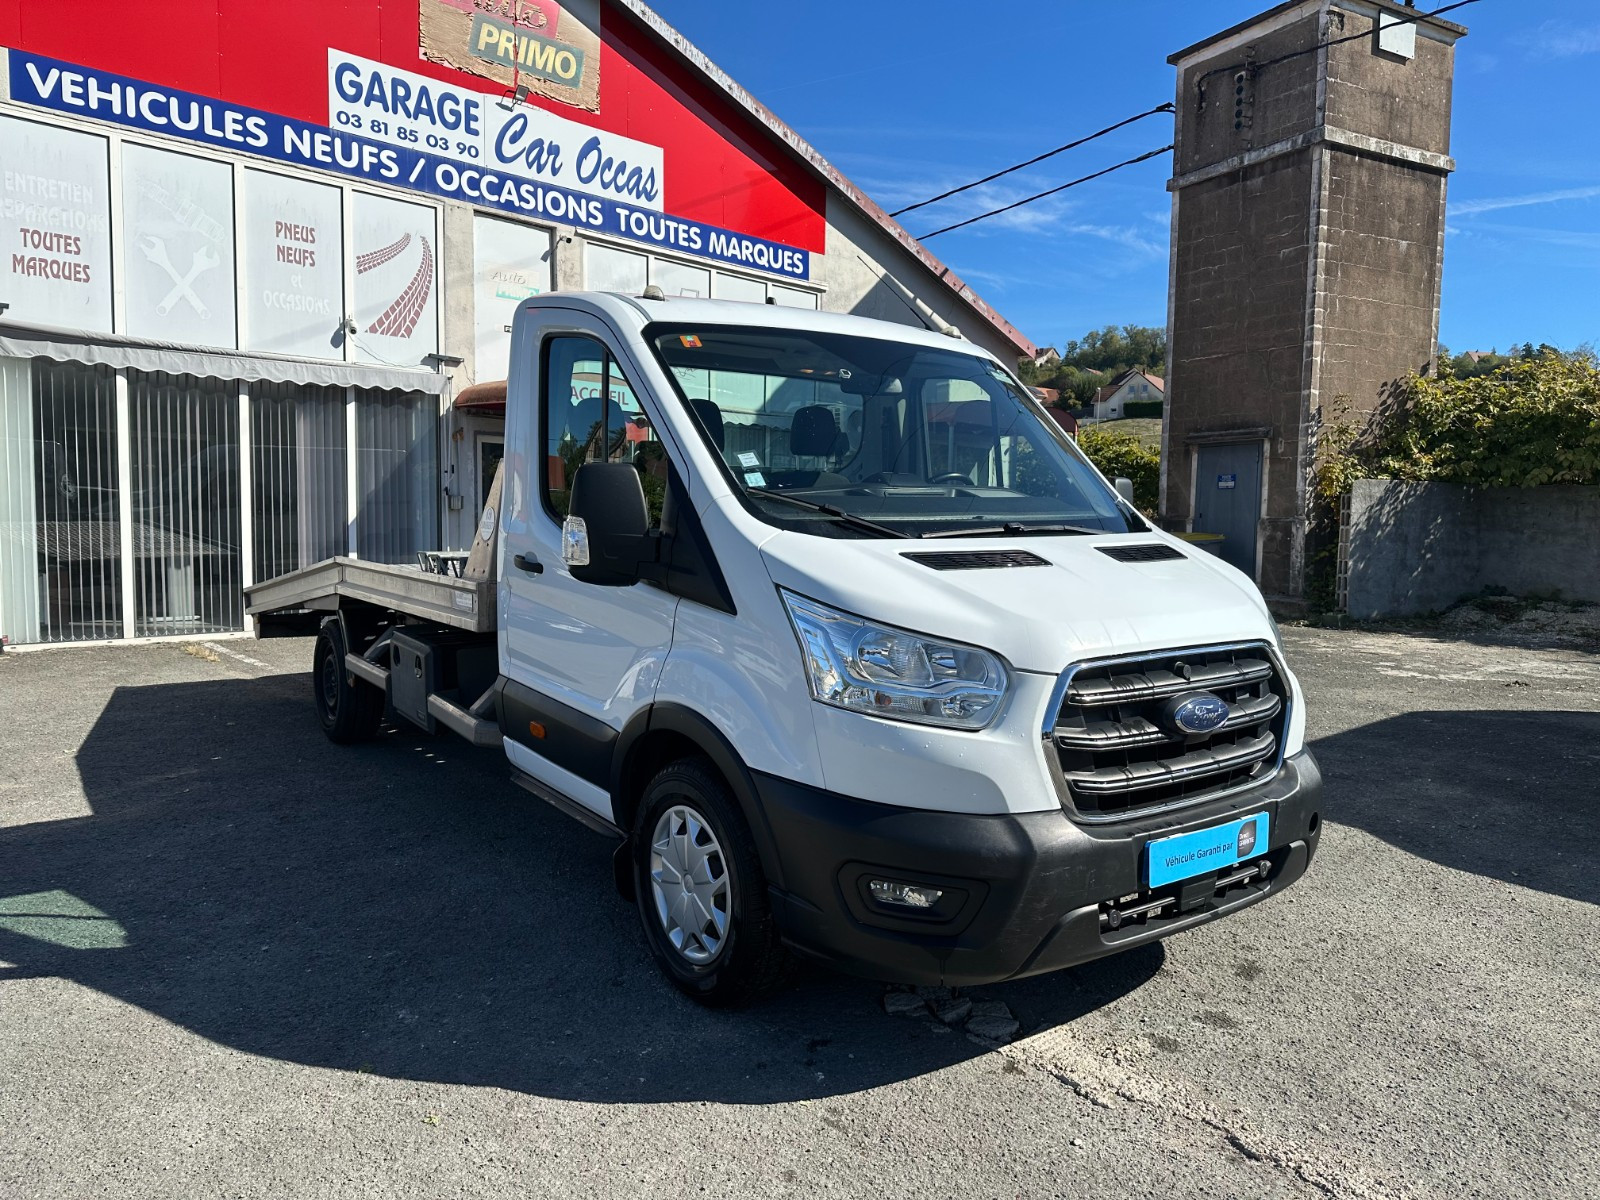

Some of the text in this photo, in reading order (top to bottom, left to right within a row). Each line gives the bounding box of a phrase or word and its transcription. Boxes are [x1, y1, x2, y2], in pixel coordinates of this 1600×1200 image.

[477, 22, 577, 80] PRIMO
[334, 62, 480, 137] GARAGE
[336, 110, 480, 158] 03 81 85 03 90
[26, 62, 804, 273] VEHICULES NEUFS / OCCASIONS TOUTES MARQUES
[494, 113, 659, 202] Car Occas
[5, 171, 93, 204] ENTRETIEN
[20, 227, 81, 256] TOUTES
[275, 220, 316, 244] PNEUS
[12, 253, 91, 284] MARQUES
[277, 244, 316, 268] NEUFS
[290, 273, 303, 289] et
[263, 289, 330, 316] OCCASIONS
[1165, 842, 1234, 867] Véhicule Garanti par
